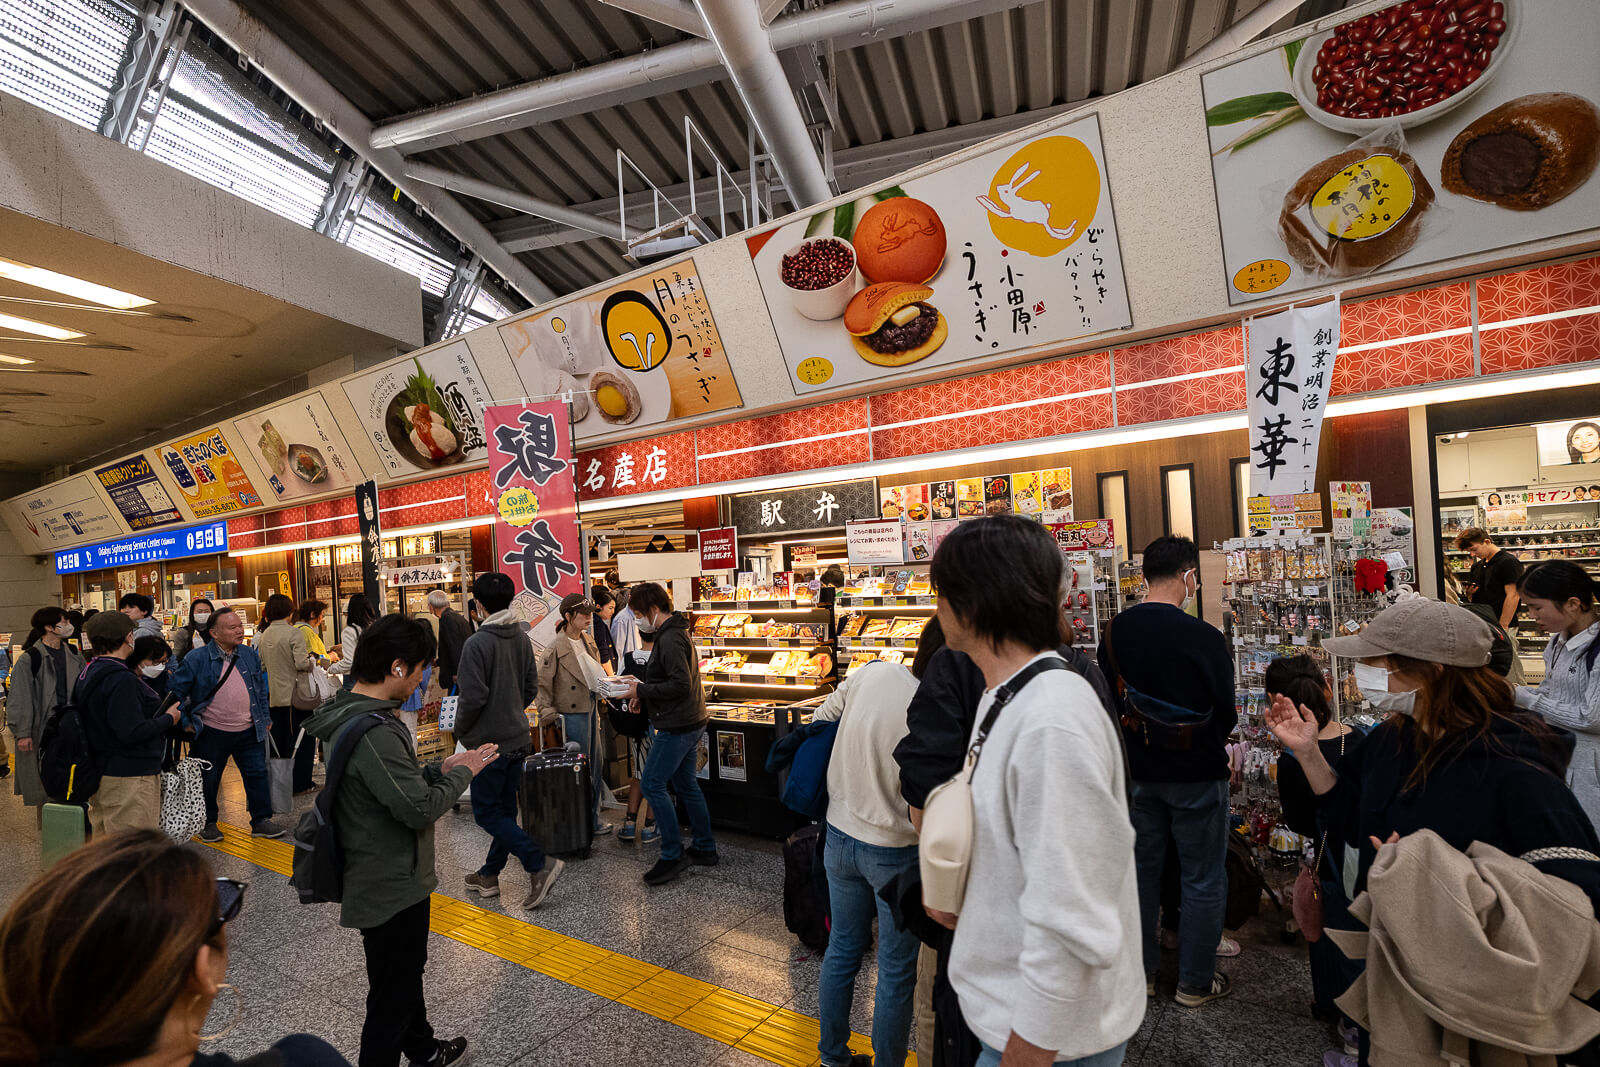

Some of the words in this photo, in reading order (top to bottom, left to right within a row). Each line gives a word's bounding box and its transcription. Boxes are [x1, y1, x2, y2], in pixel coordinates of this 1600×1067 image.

[1087, 228, 1107, 304] どらやき
[1247, 273, 1279, 291] 菜の花
[1000, 264, 1037, 335] 小田原
[652, 278, 717, 403] 月のうさぎ
[1251, 336, 1299, 497] 東華
[572, 446, 668, 492] 名産店
[760, 491, 840, 527] 駅弁
[1522, 490, 1571, 503] 朝セブン
[112, 542, 132, 556] Sightseeing
[133, 540, 147, 551] Service
[147, 538, 160, 548] Center
[703, 543, 732, 553] 店内のレジにて
[1056, 529, 1083, 543] 梅丸
